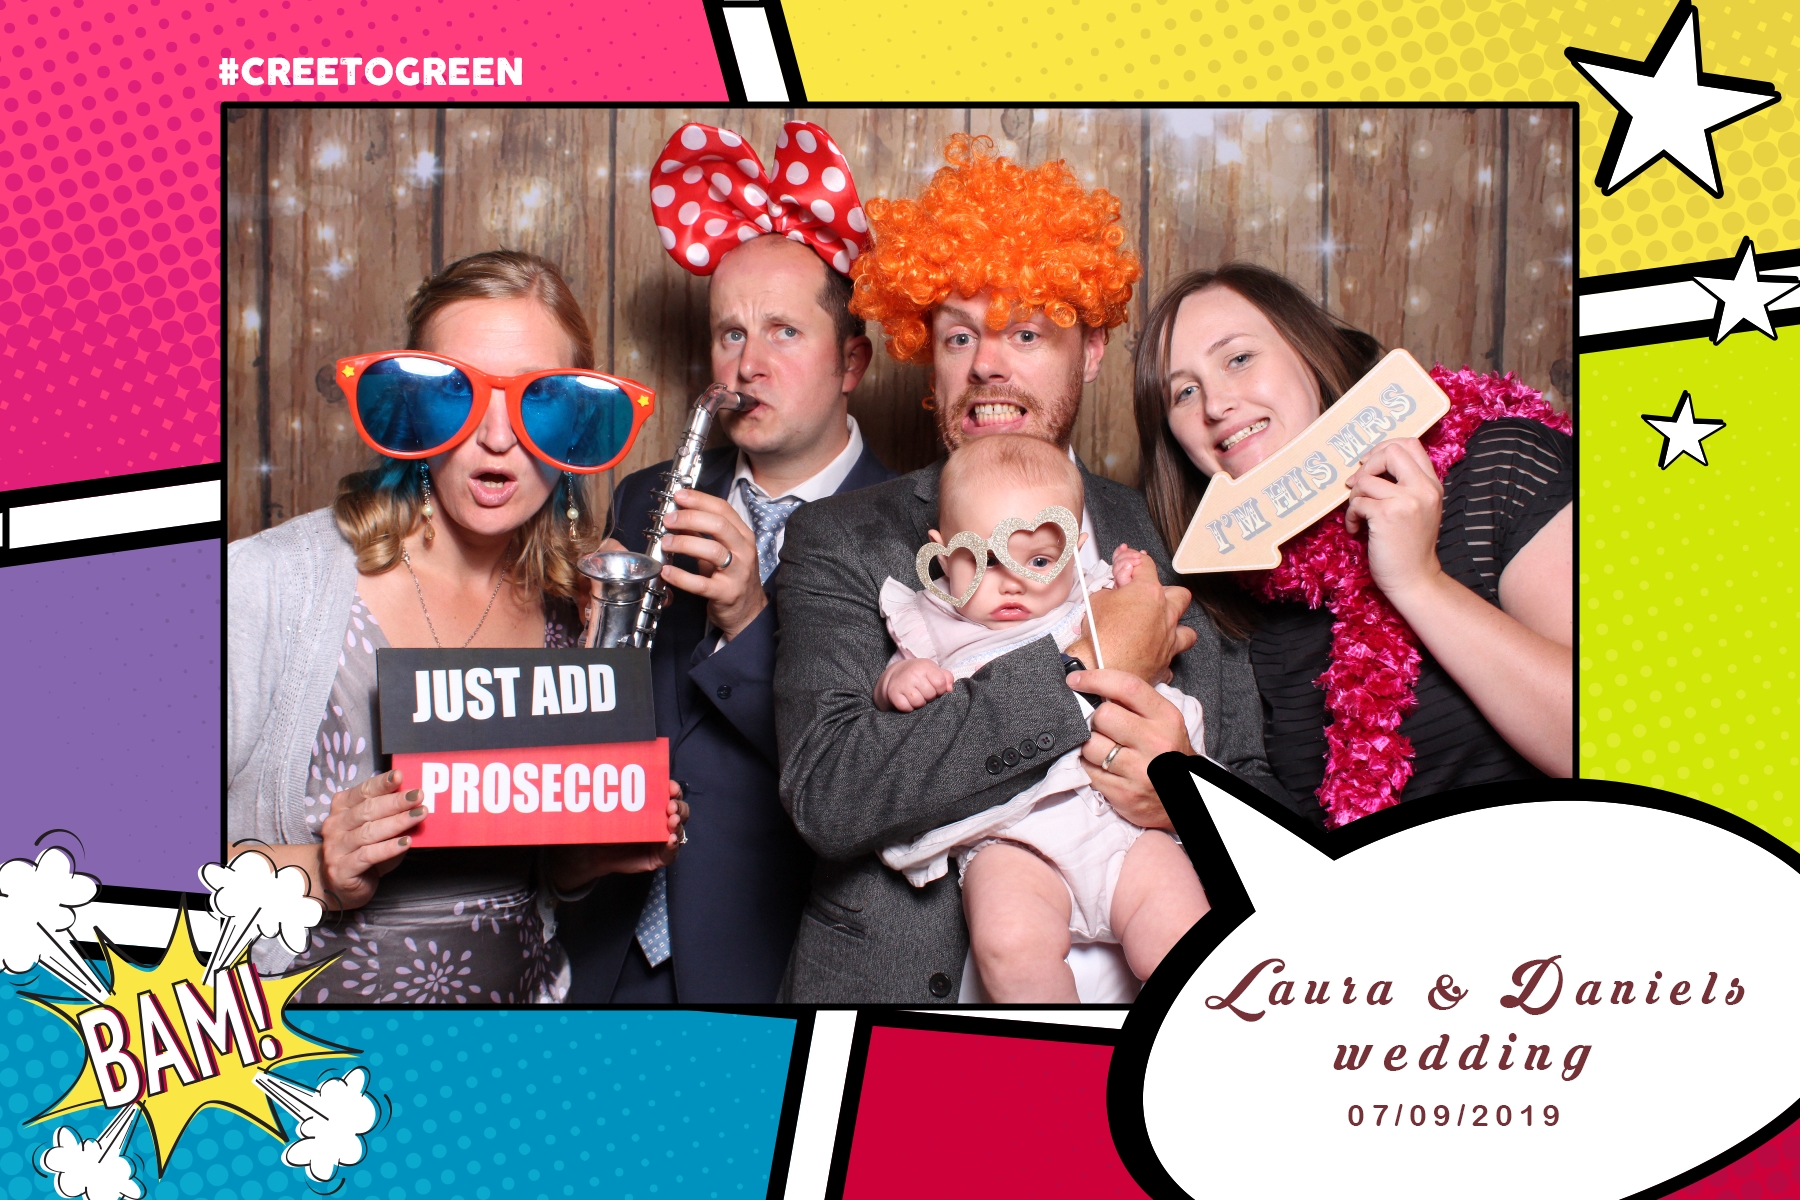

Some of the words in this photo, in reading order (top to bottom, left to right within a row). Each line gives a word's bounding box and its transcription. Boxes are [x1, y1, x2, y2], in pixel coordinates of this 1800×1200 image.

[1261, 451, 1338, 519] HIS
[1326, 383, 1417, 467] MRS
[412, 667, 521, 723] JUST
[531, 664, 617, 716] ADD
[421, 762, 646, 814] PROSECCO
